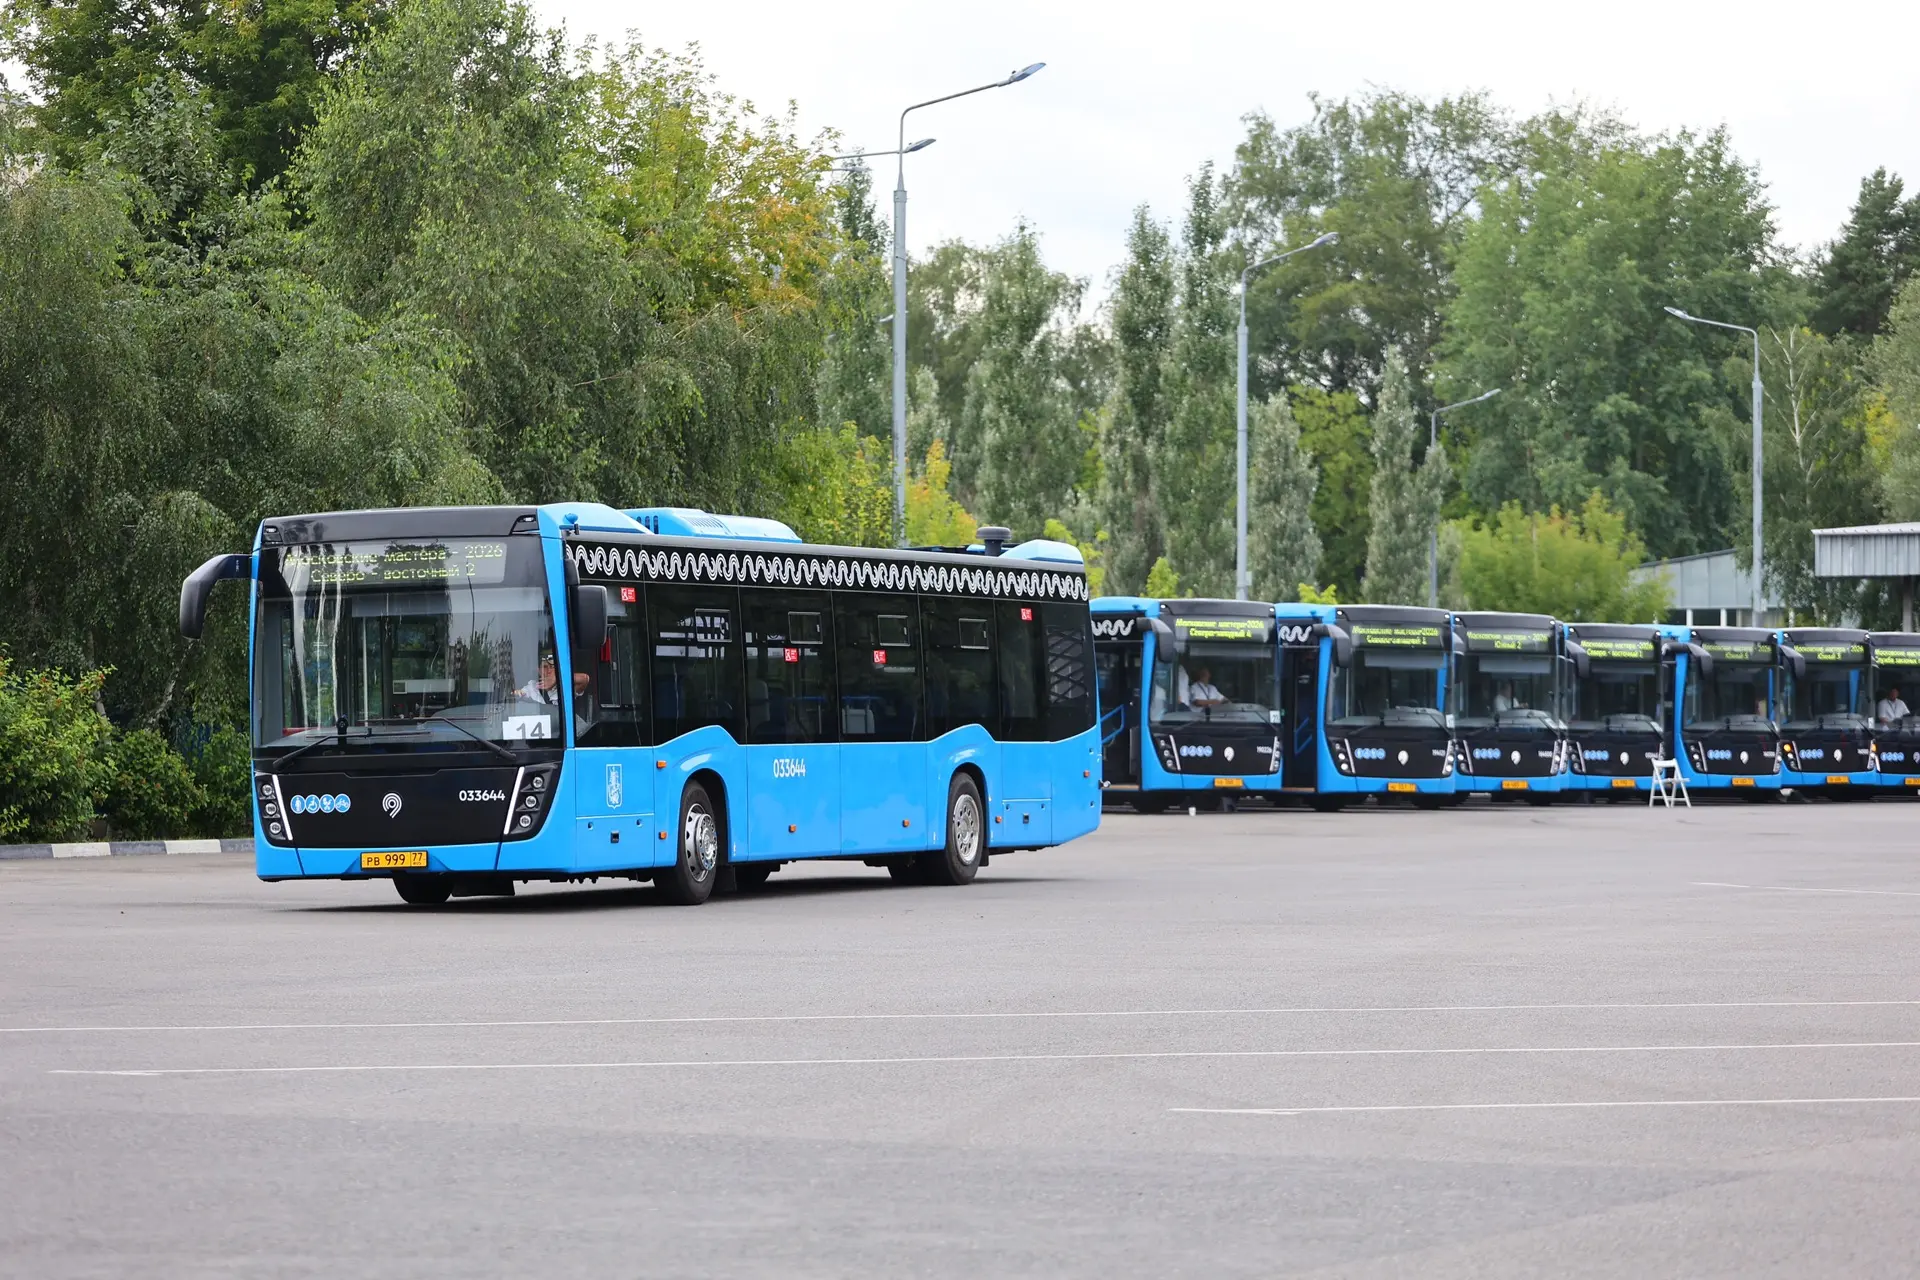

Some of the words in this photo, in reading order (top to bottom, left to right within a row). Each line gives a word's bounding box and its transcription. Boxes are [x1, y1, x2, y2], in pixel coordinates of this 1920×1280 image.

[285, 553, 378, 566] Московские
[384, 549, 446, 562] мастера
[464, 544, 503, 559] 2026
[311, 568, 365, 583] Северо
[384, 564, 460, 580] восточный
[465, 563, 476, 576] 2
[516, 722, 545, 739] 14
[773, 758, 807, 778] 033644
[459, 790, 506, 801] 033644
[385, 854, 406, 866] 999
[412, 853, 424, 861] 77
